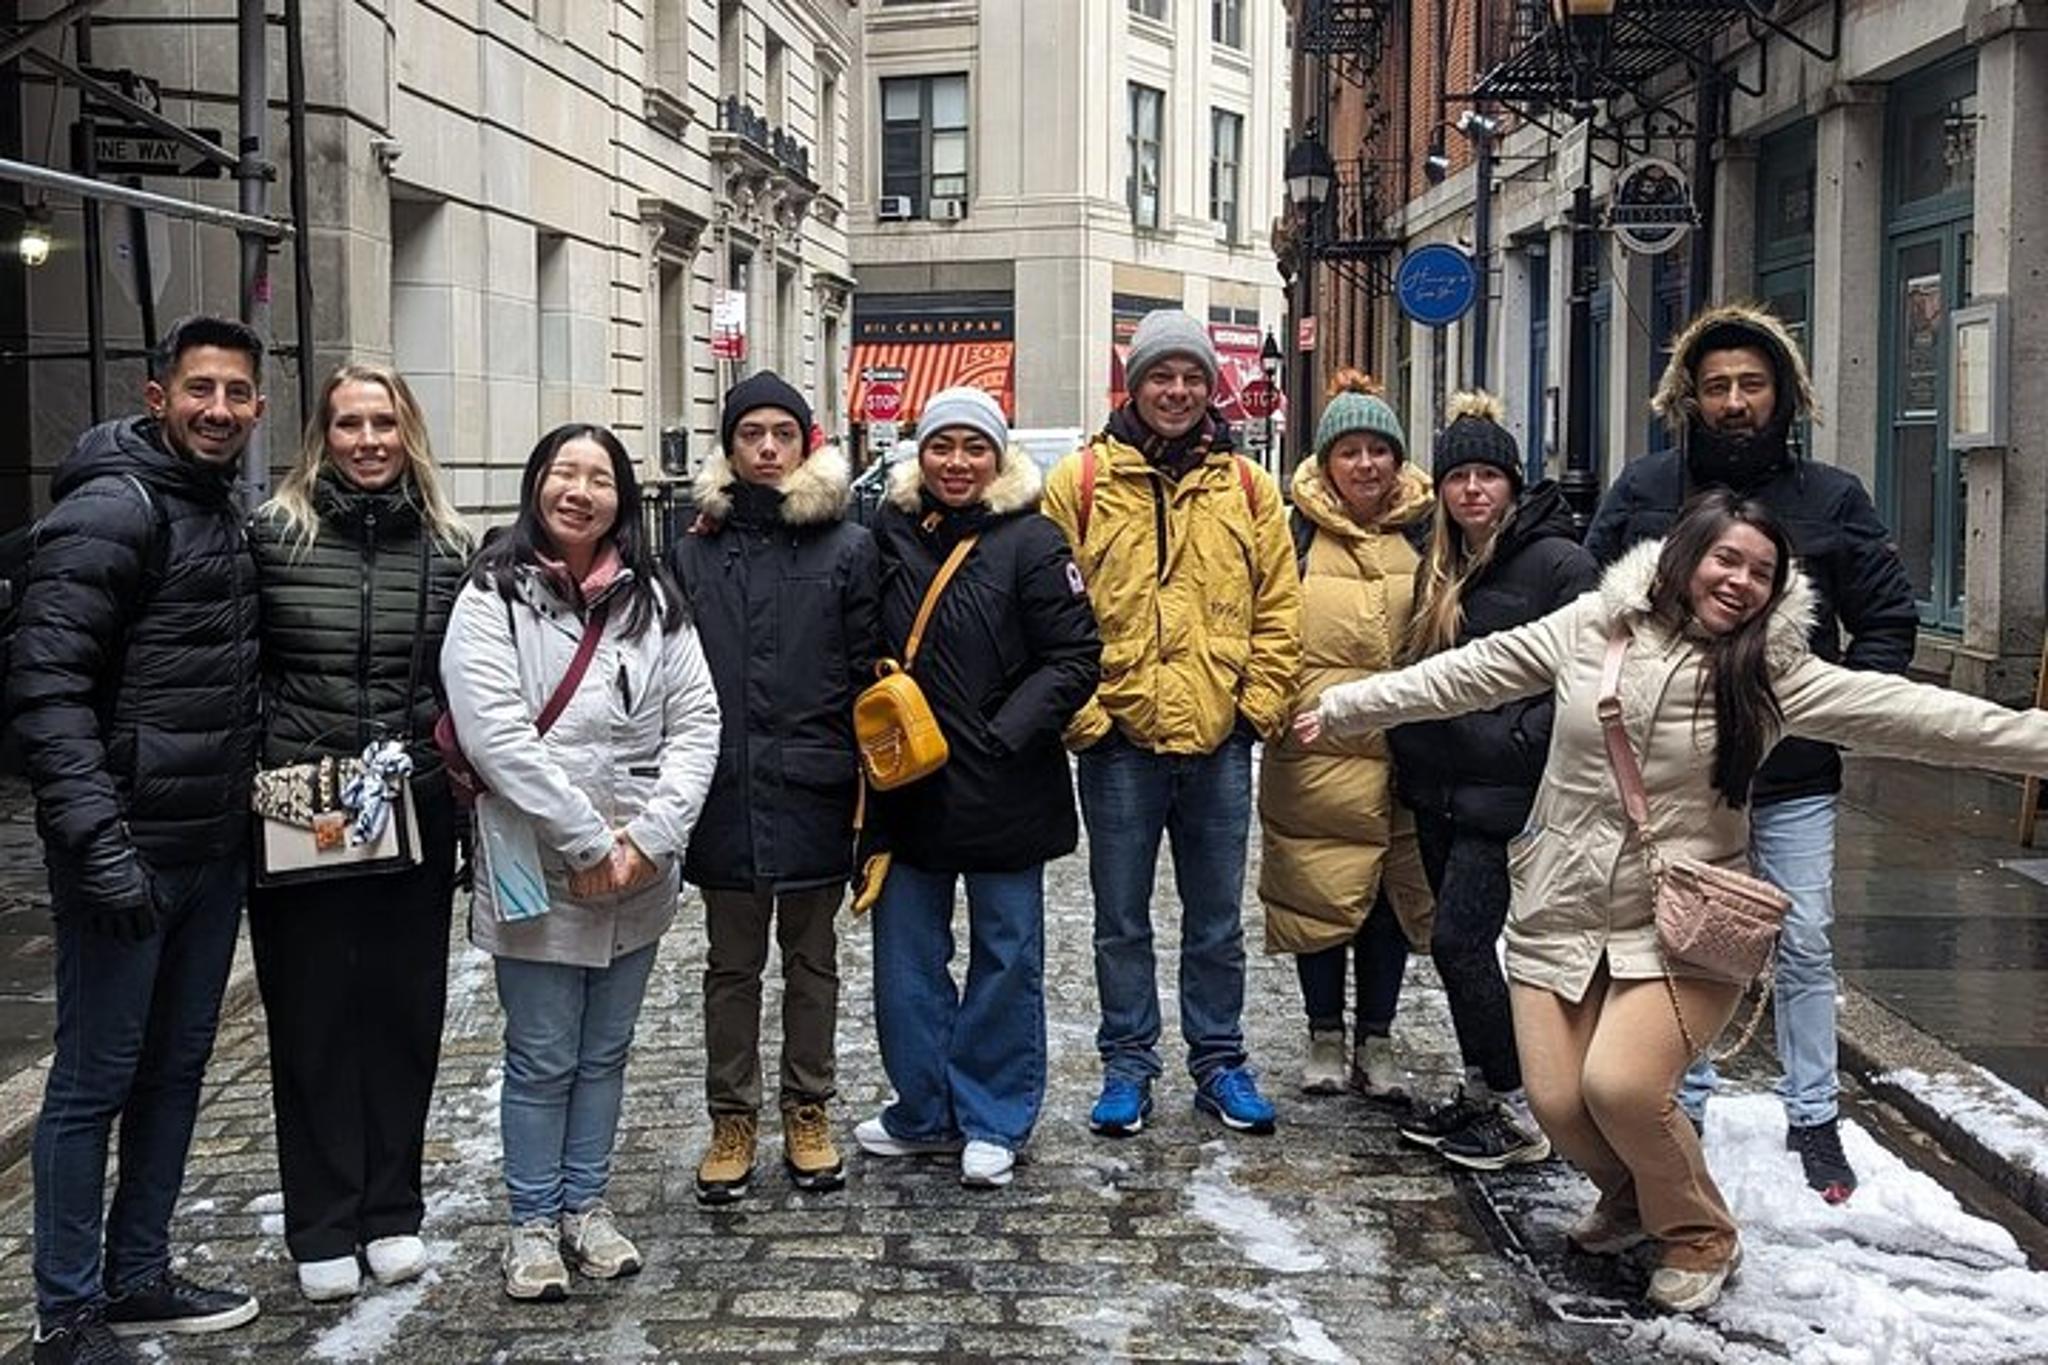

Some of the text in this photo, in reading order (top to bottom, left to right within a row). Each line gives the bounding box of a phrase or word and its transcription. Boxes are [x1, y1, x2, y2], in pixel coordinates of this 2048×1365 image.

[96, 141, 180, 160] NE WAY
[866, 394, 899, 410] STOP
